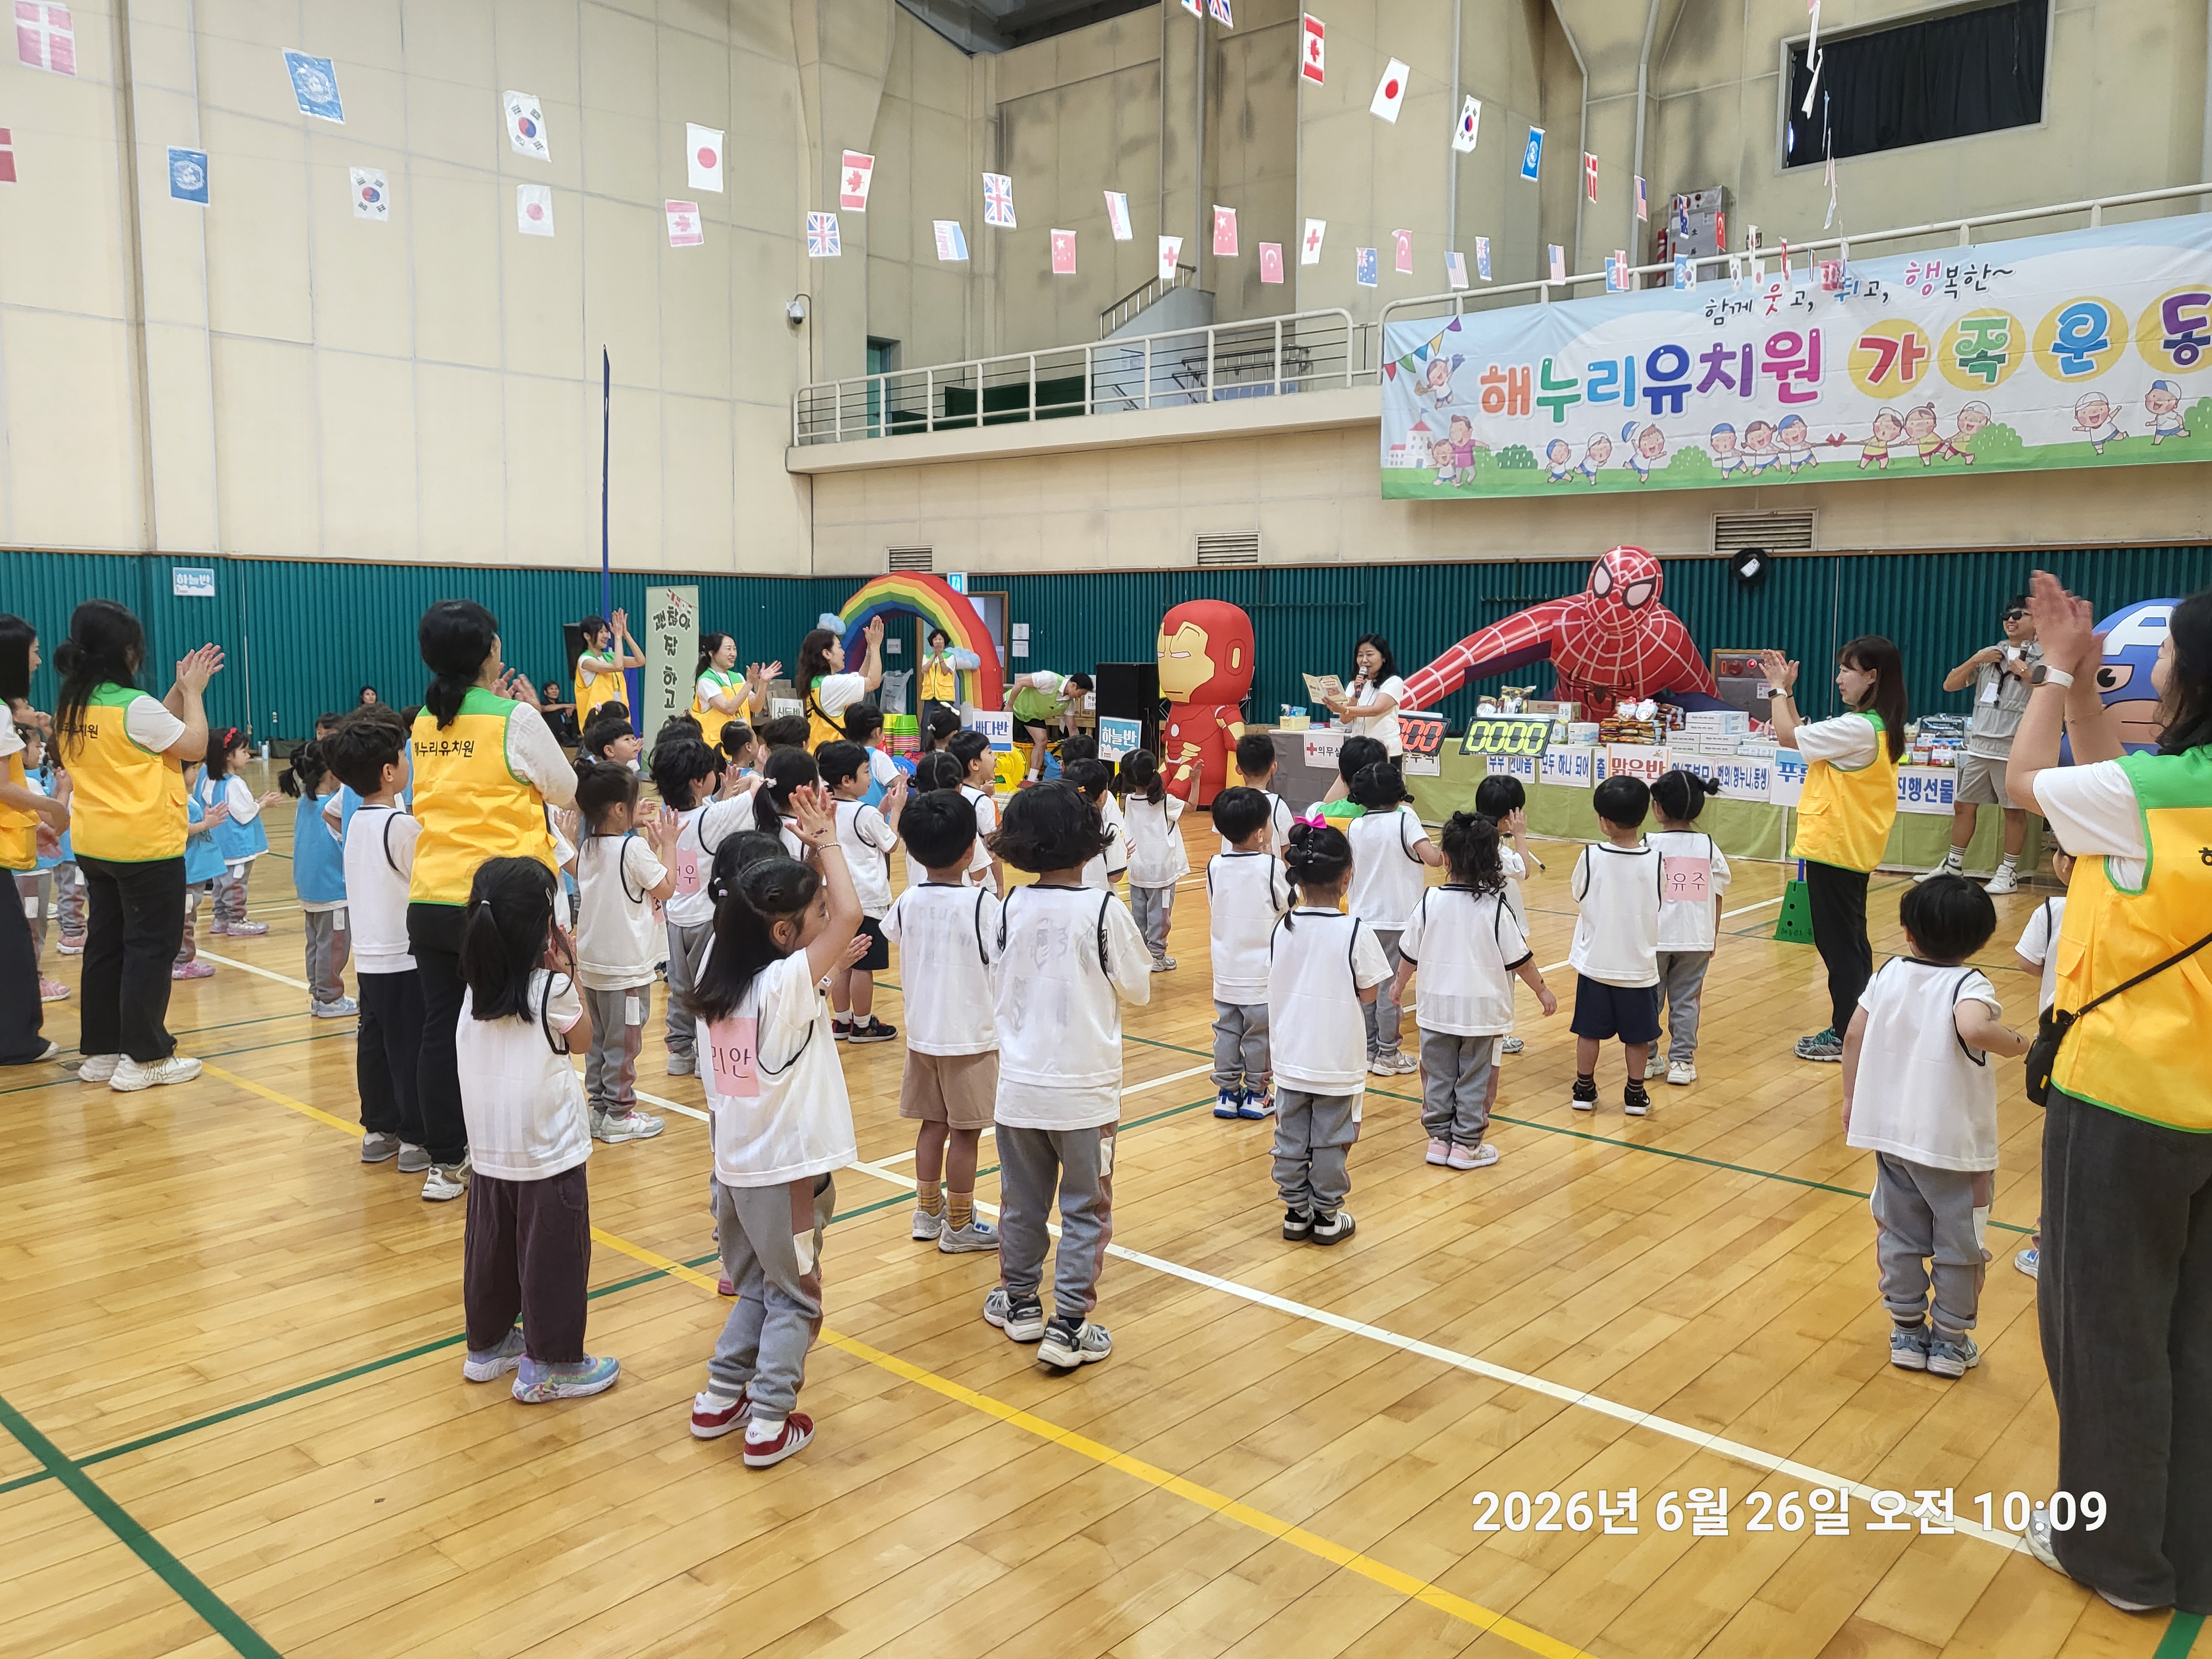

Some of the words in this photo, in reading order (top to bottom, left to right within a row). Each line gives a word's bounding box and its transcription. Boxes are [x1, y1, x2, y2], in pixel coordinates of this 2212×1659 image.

[1705, 298, 1753, 325] 함께
[1905, 261, 2013, 299] 행복한~
[1480, 328, 1821, 423] 해누리유치원
[653, 606, 691, 631] 괜찮아
[975, 721, 1009, 735] 바다반
[1102, 727, 1137, 747] 하늘반
[1466, 721, 1548, 754] 0000
[1542, 754, 1554, 775] 모두
[1558, 754, 1572, 776] 하나
[1576, 755, 1589, 778] 되어
[1612, 758, 1666, 779] 맑은반
